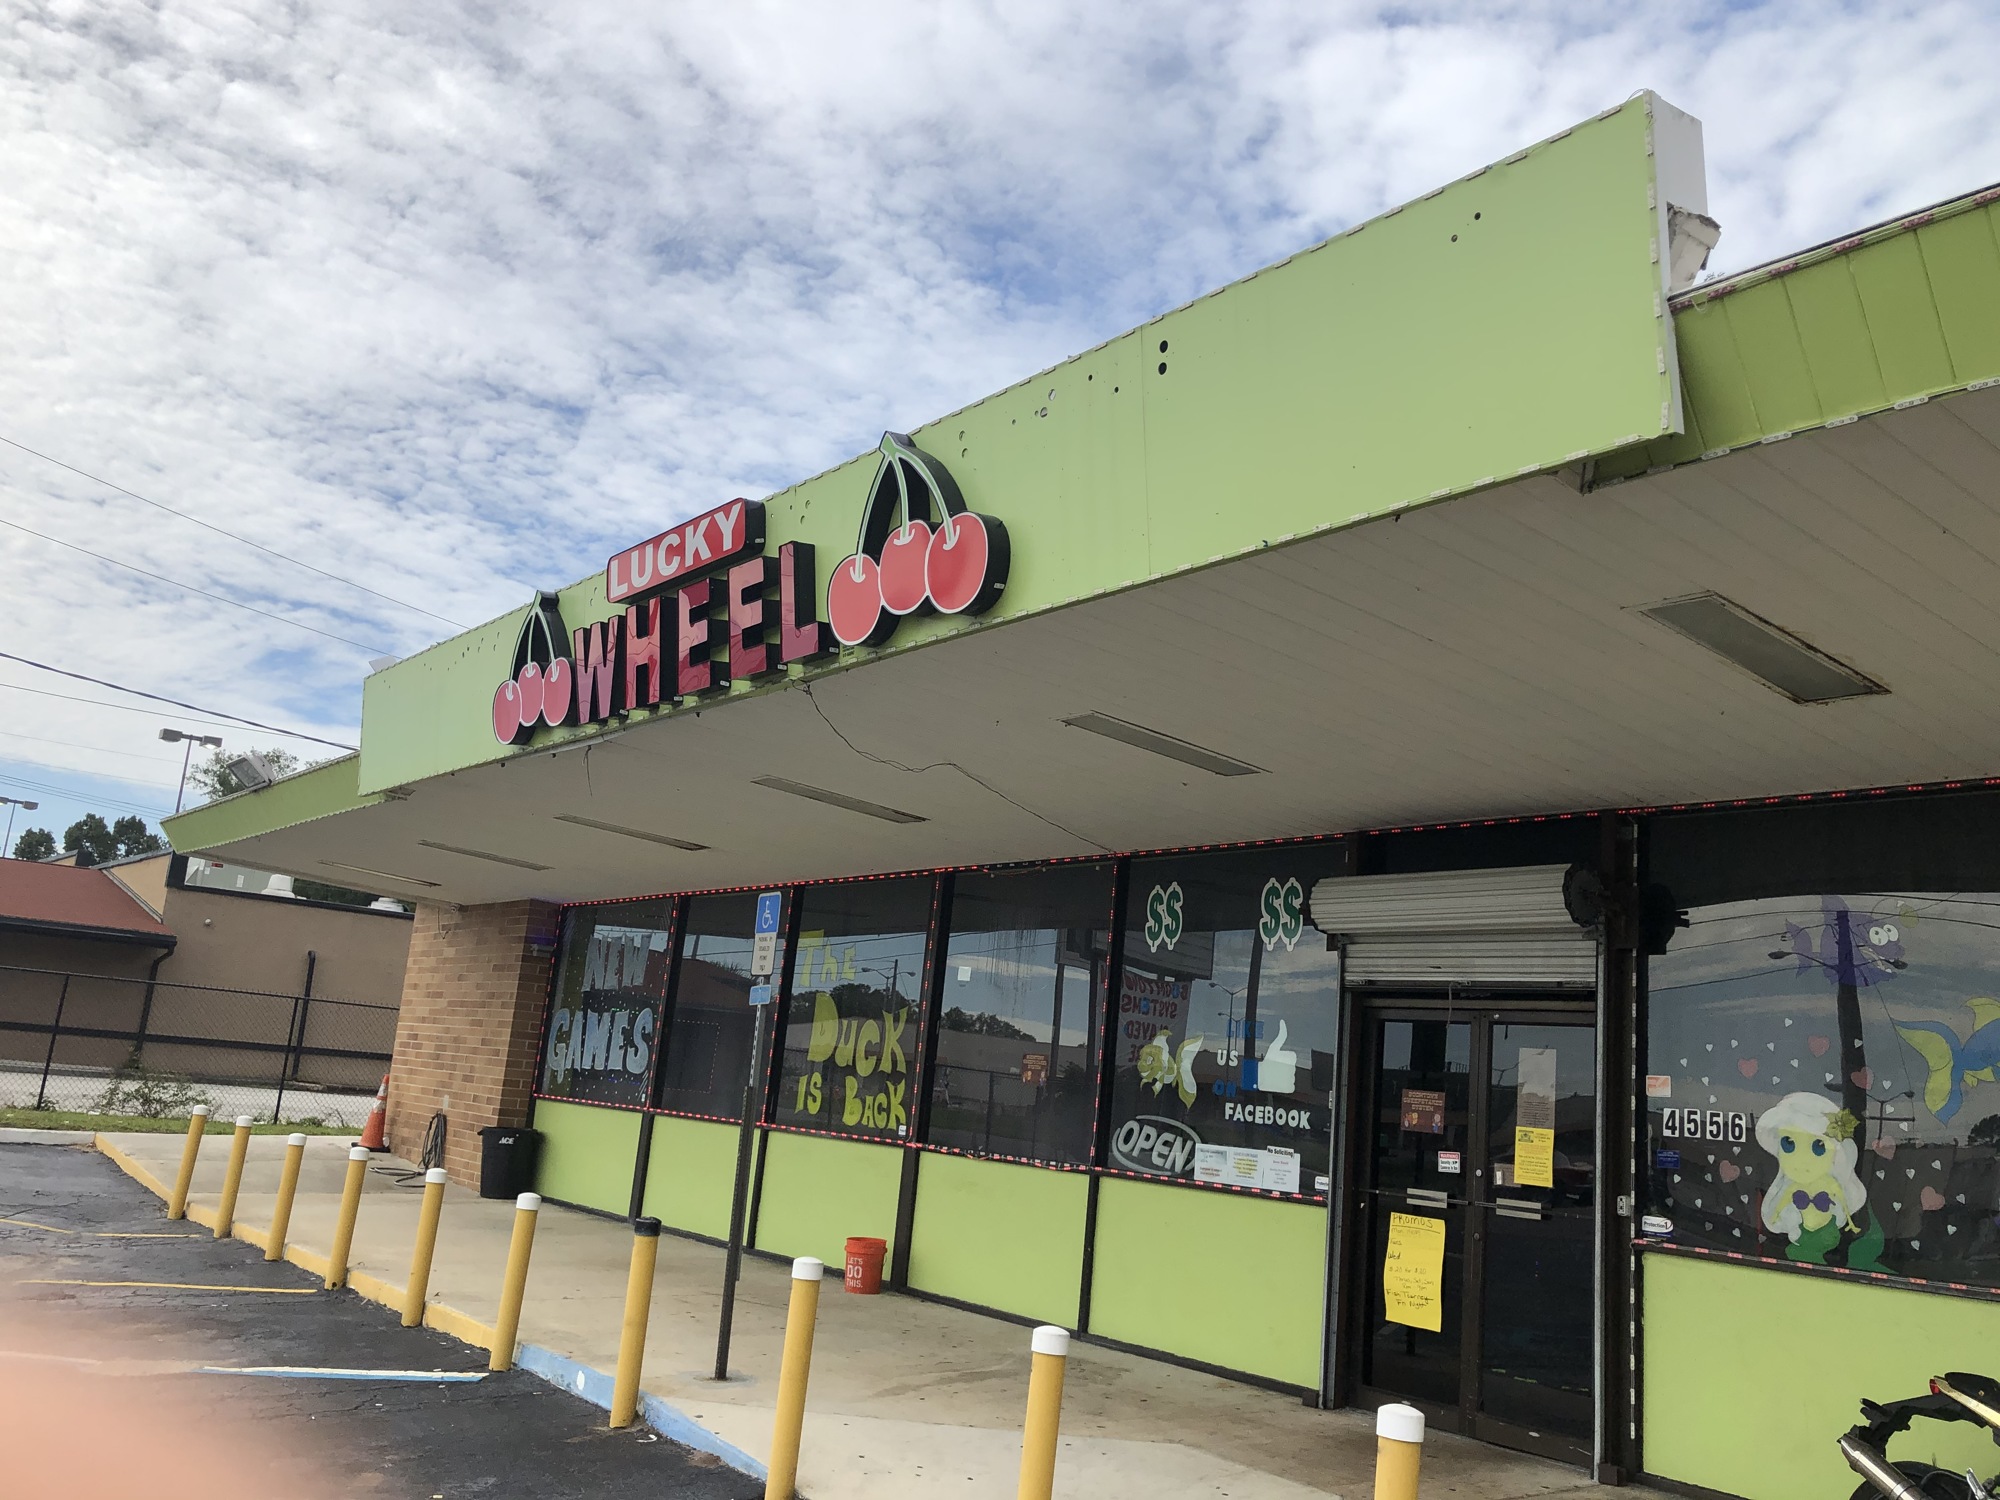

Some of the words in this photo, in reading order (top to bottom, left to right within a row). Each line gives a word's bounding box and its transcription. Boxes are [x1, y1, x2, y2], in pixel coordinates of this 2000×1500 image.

[611, 502, 742, 599] LUCKY
[574, 541, 818, 724] WHEEL
[581, 934, 651, 991] NEW
[547, 1008, 653, 1084] GAMES
[1217, 1049, 1239, 1066] US
[795, 1072, 822, 1115] IS
[1225, 1102, 1311, 1129] FACEBOOK
[1665, 1110, 1744, 1140] 4556
[498, 1136, 515, 1145] ACE
[1118, 1120, 1194, 1174] OPEN
[1274, 1148, 1294, 1159] Soliciting
[1392, 1213, 1433, 1228] PROMOS
[847, 1264, 863, 1279] DO
